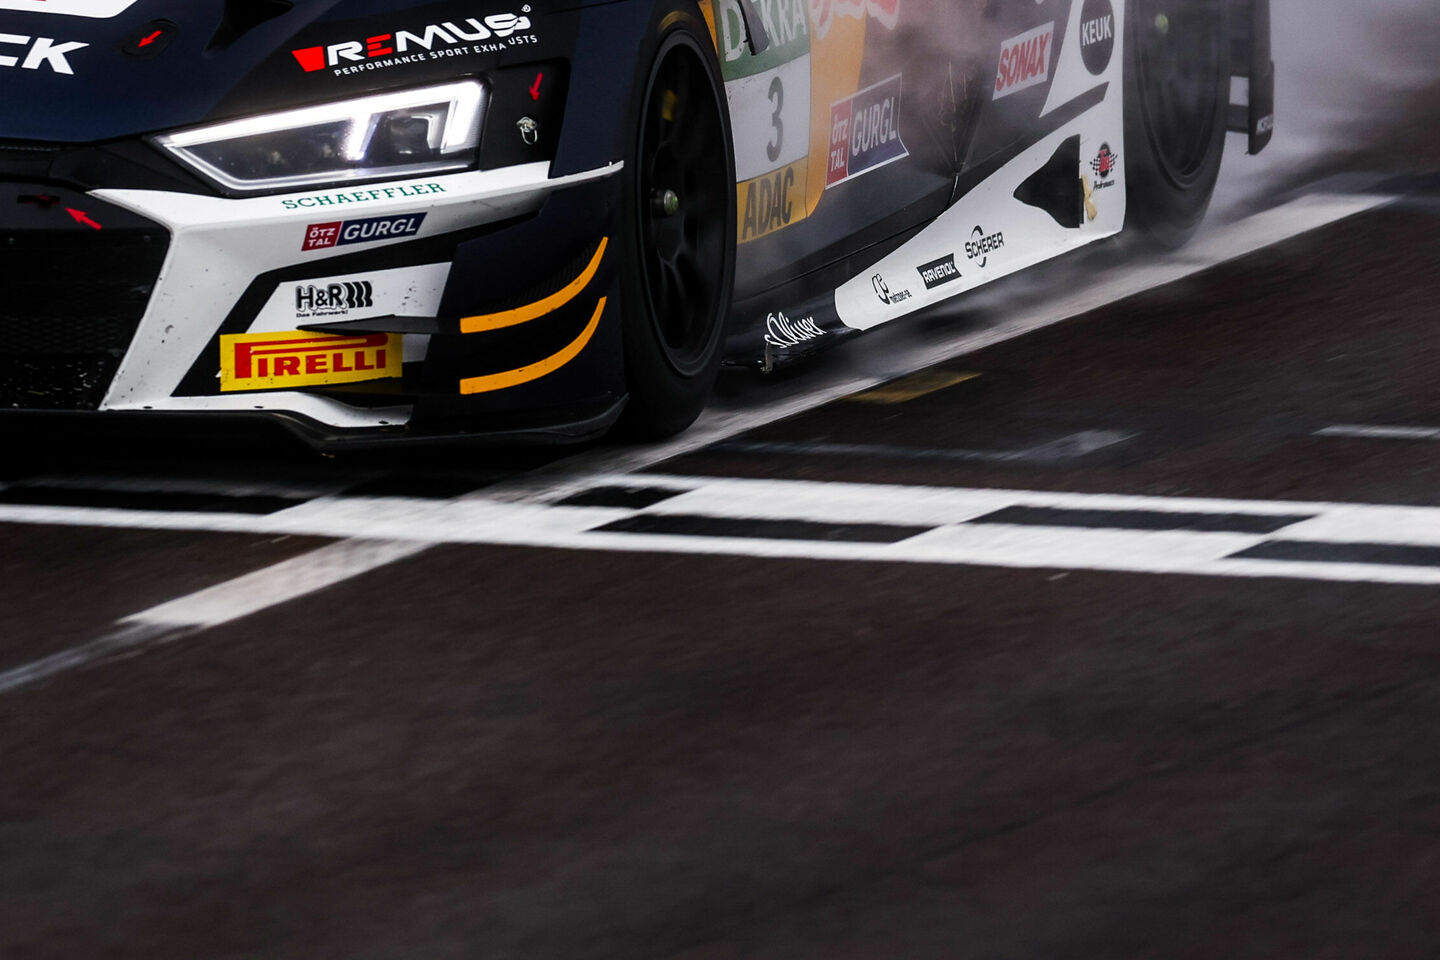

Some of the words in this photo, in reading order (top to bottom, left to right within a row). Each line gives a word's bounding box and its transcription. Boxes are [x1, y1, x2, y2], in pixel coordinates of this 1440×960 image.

[327, 13, 531, 66] REMUS
[1082, 15, 1112, 47] KEUK
[334, 52, 426, 77] PERFORMANCE
[429, 46, 469, 63] SPORT
[474, 34, 538, 54] EXHAUSTS
[995, 32, 1050, 91] SONAX
[766, 76, 784, 162] 3
[851, 96, 897, 157] GURGL
[830, 151, 846, 172] TAL
[282, 183, 447, 209] SCHAEFFLER
[742, 166, 795, 239] ADAC
[308, 239, 332, 247] TAL
[310, 227, 336, 238] ÖTZ
[343, 218, 417, 240] GURGL
[965, 231, 1005, 259] SCHERER
[922, 261, 956, 283] RAVENOL
[296, 283, 348, 312] H&R
[234, 333, 388, 379] PIRELLI
